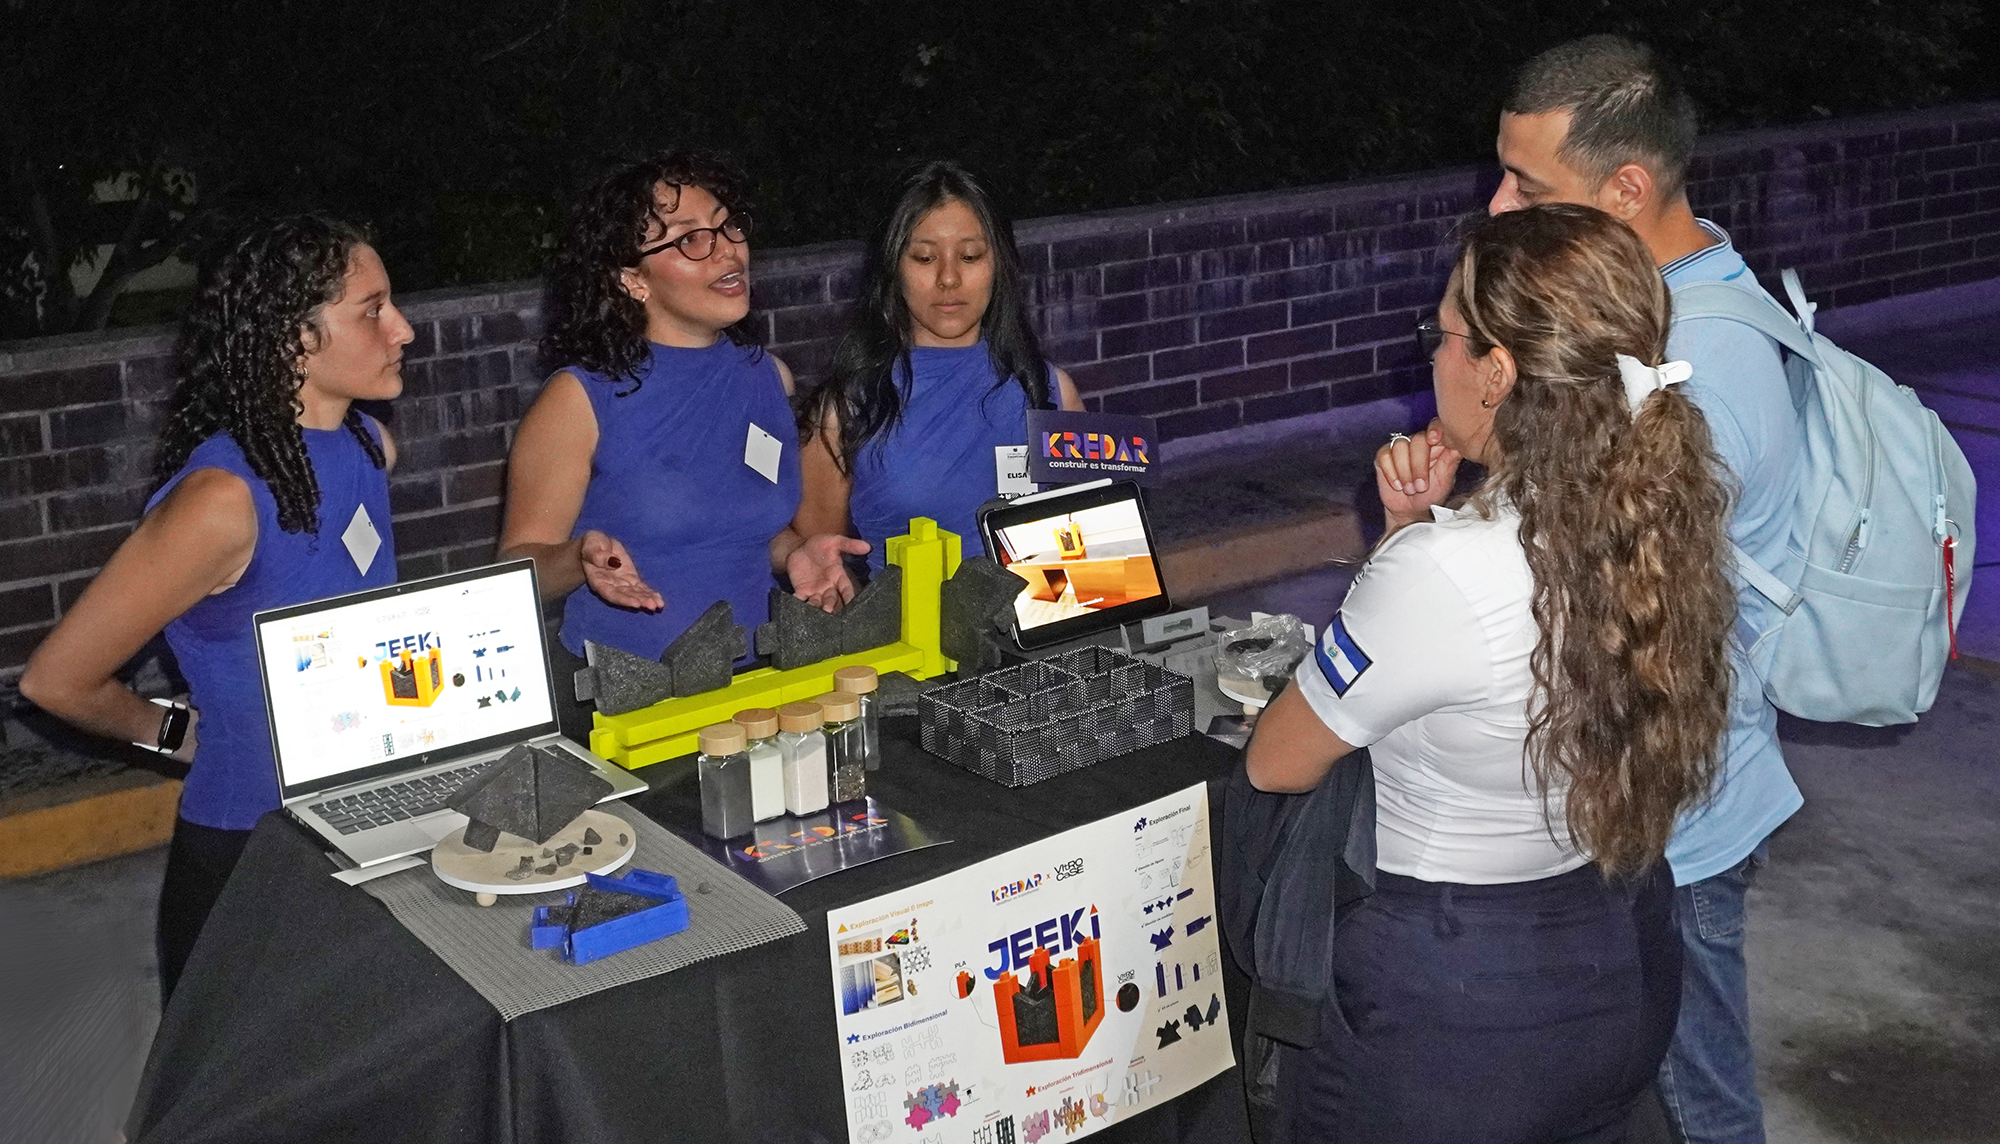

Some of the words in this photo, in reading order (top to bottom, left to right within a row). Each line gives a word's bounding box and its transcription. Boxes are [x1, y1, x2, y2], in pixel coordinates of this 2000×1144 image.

[1042, 431, 1150, 464] KREDAR
[1049, 460, 1088, 469] construir
[1101, 462, 1146, 473] transformar
[1149, 811, 1179, 826] Exploración
[1178, 805, 1192, 814] Final
[758, 845, 806, 863] construir
[991, 873, 1043, 903] KREDAR
[850, 914, 890, 931] Exploración
[889, 907, 910, 918] Visual
[916, 899, 935, 911] Inspo
[954, 960, 967, 969] PLA
[862, 1025, 903, 1043] Exploración
[903, 1009, 948, 1029] Bidimensional
[1037, 1074, 1073, 1094] Exploración
[1071, 1057, 1114, 1081] Tridimensional
